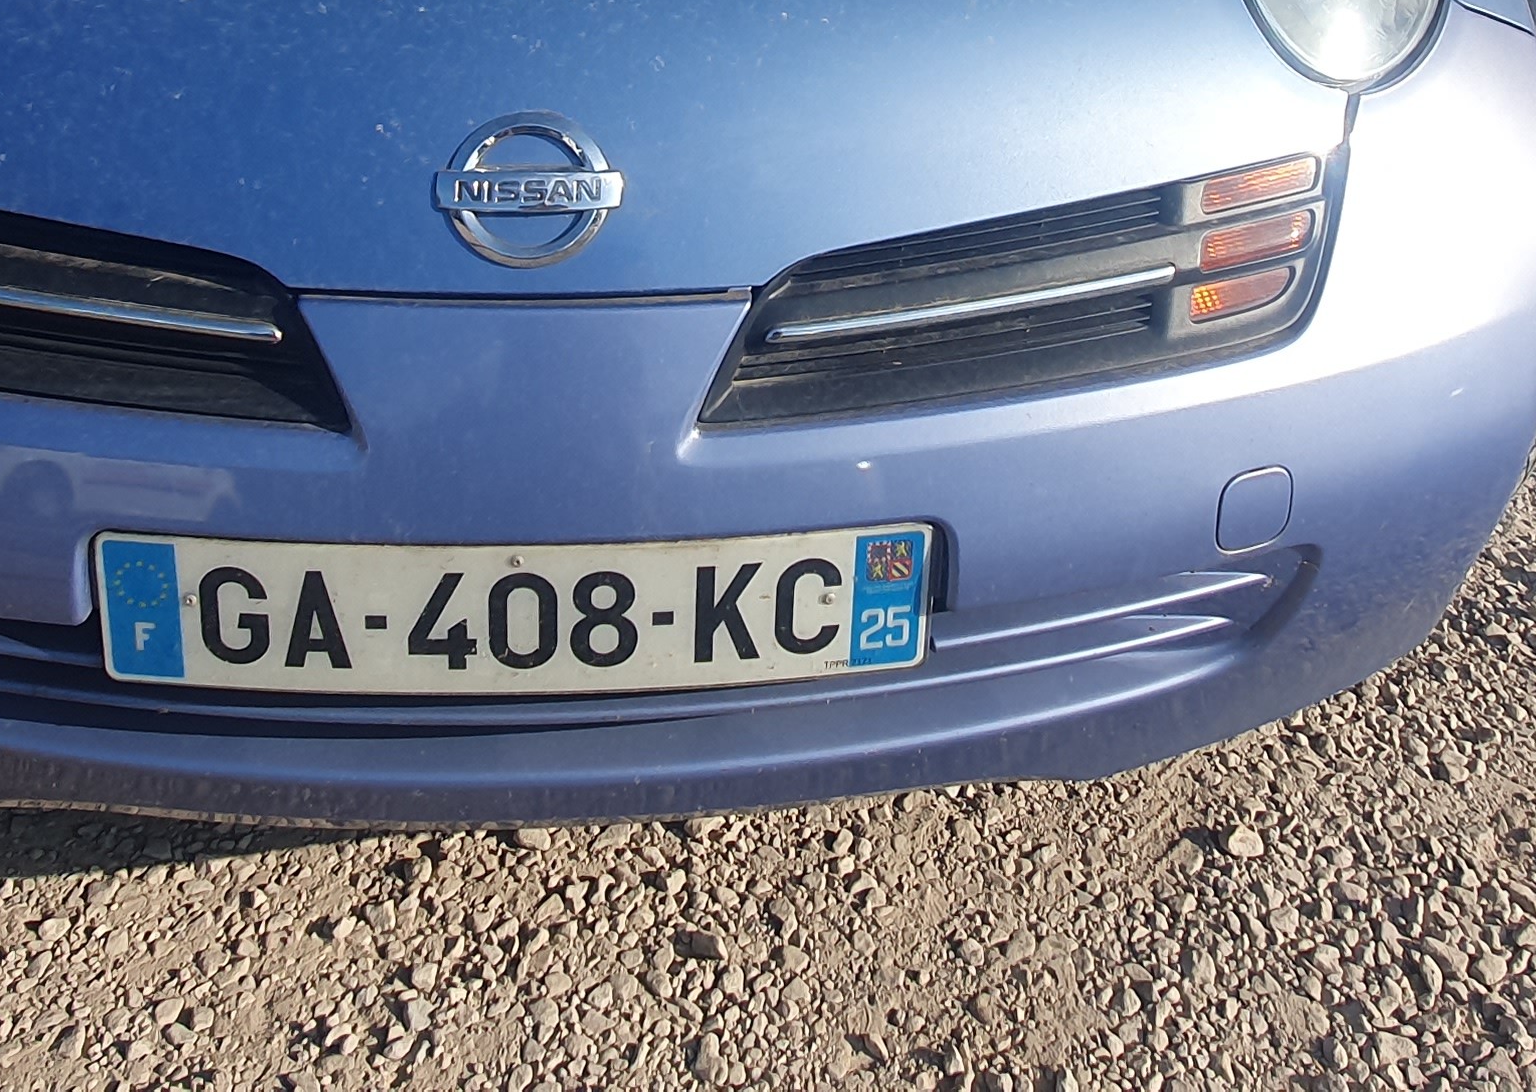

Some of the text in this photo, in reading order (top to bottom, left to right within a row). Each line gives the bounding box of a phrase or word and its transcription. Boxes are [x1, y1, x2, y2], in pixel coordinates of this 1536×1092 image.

[454, 178, 602, 204] NISSAN
[198, 558, 843, 669] GA-408-KC
[860, 605, 911, 650] 25
[135, 623, 153, 651] F
